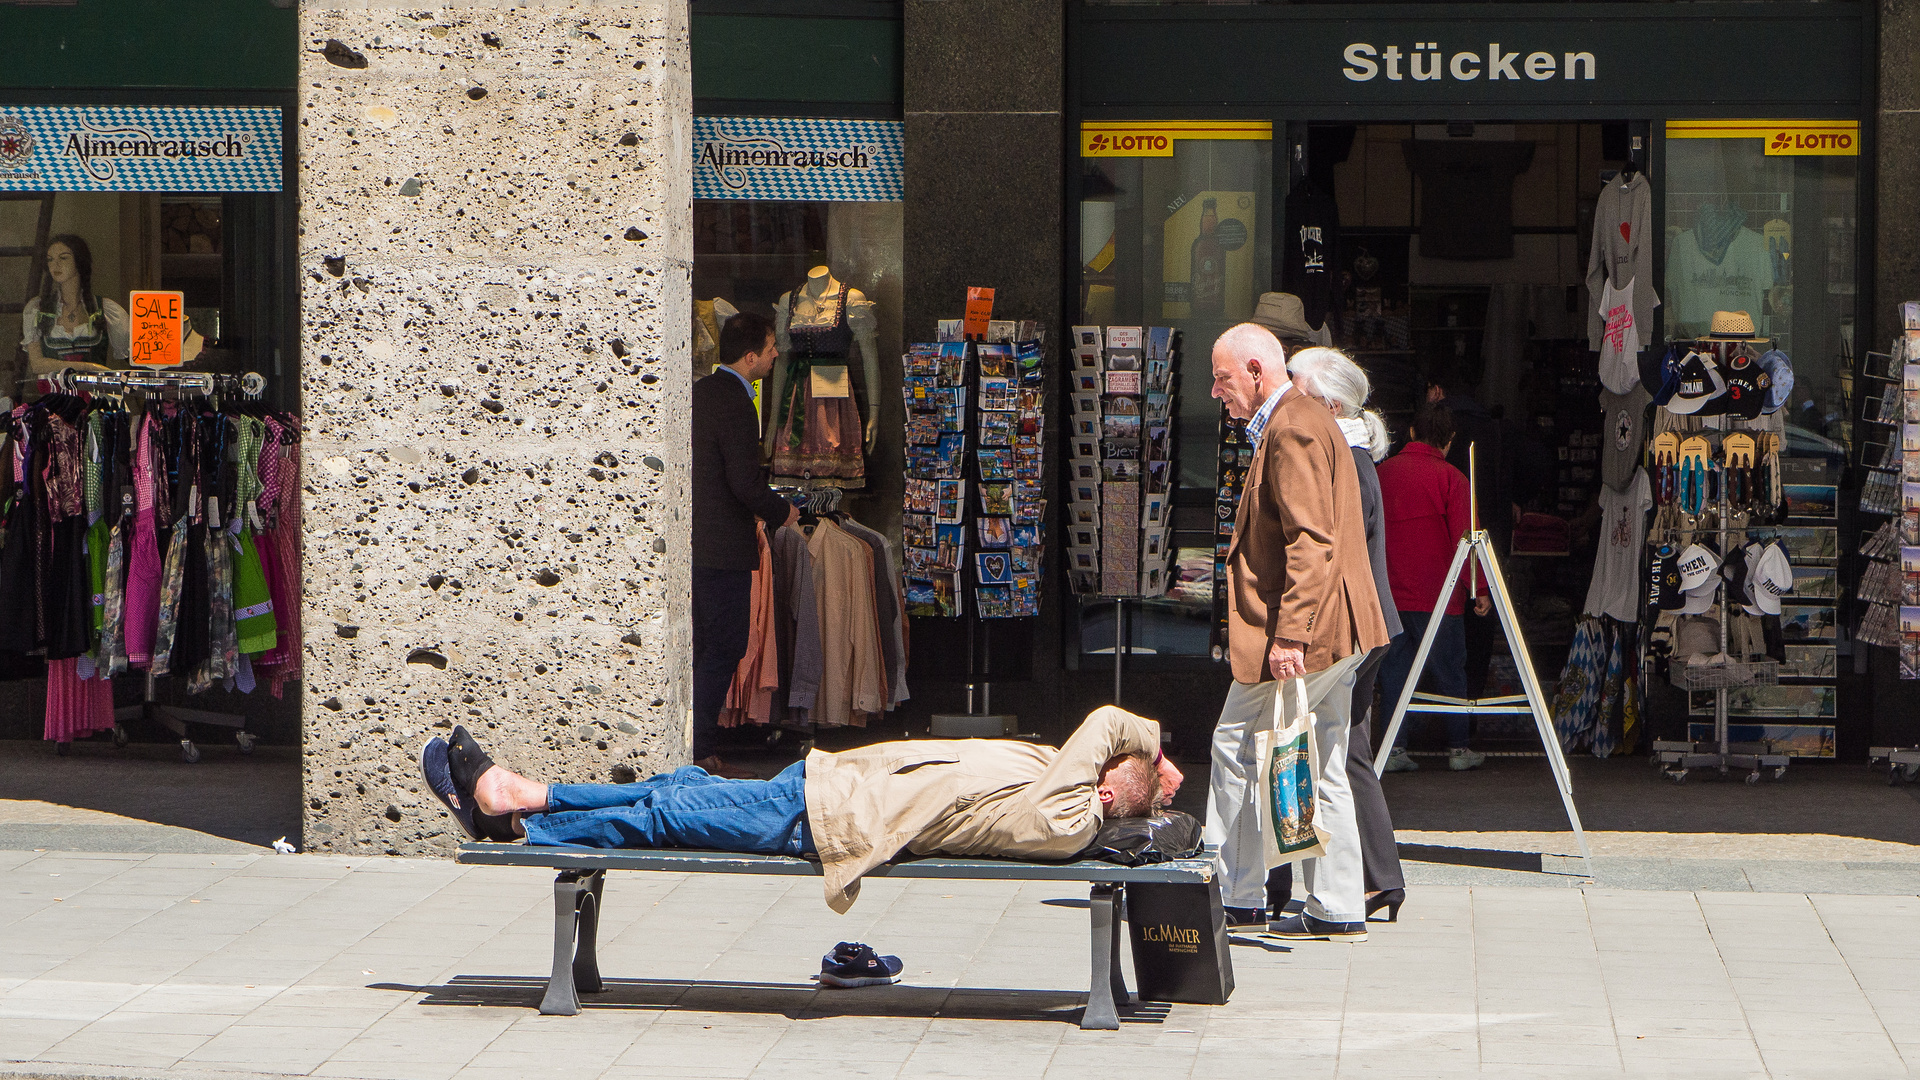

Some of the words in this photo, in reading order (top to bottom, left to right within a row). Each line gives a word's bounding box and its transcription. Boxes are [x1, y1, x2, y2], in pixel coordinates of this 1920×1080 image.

[1343, 42, 1596, 82] Stücken
[1112, 135, 1168, 151] LOTTO
[1795, 133, 1852, 149] LOTTO
[1167, 193, 1187, 213] NEU
[135, 297, 178, 320] SALE
[1731, 386, 1741, 400] 3
